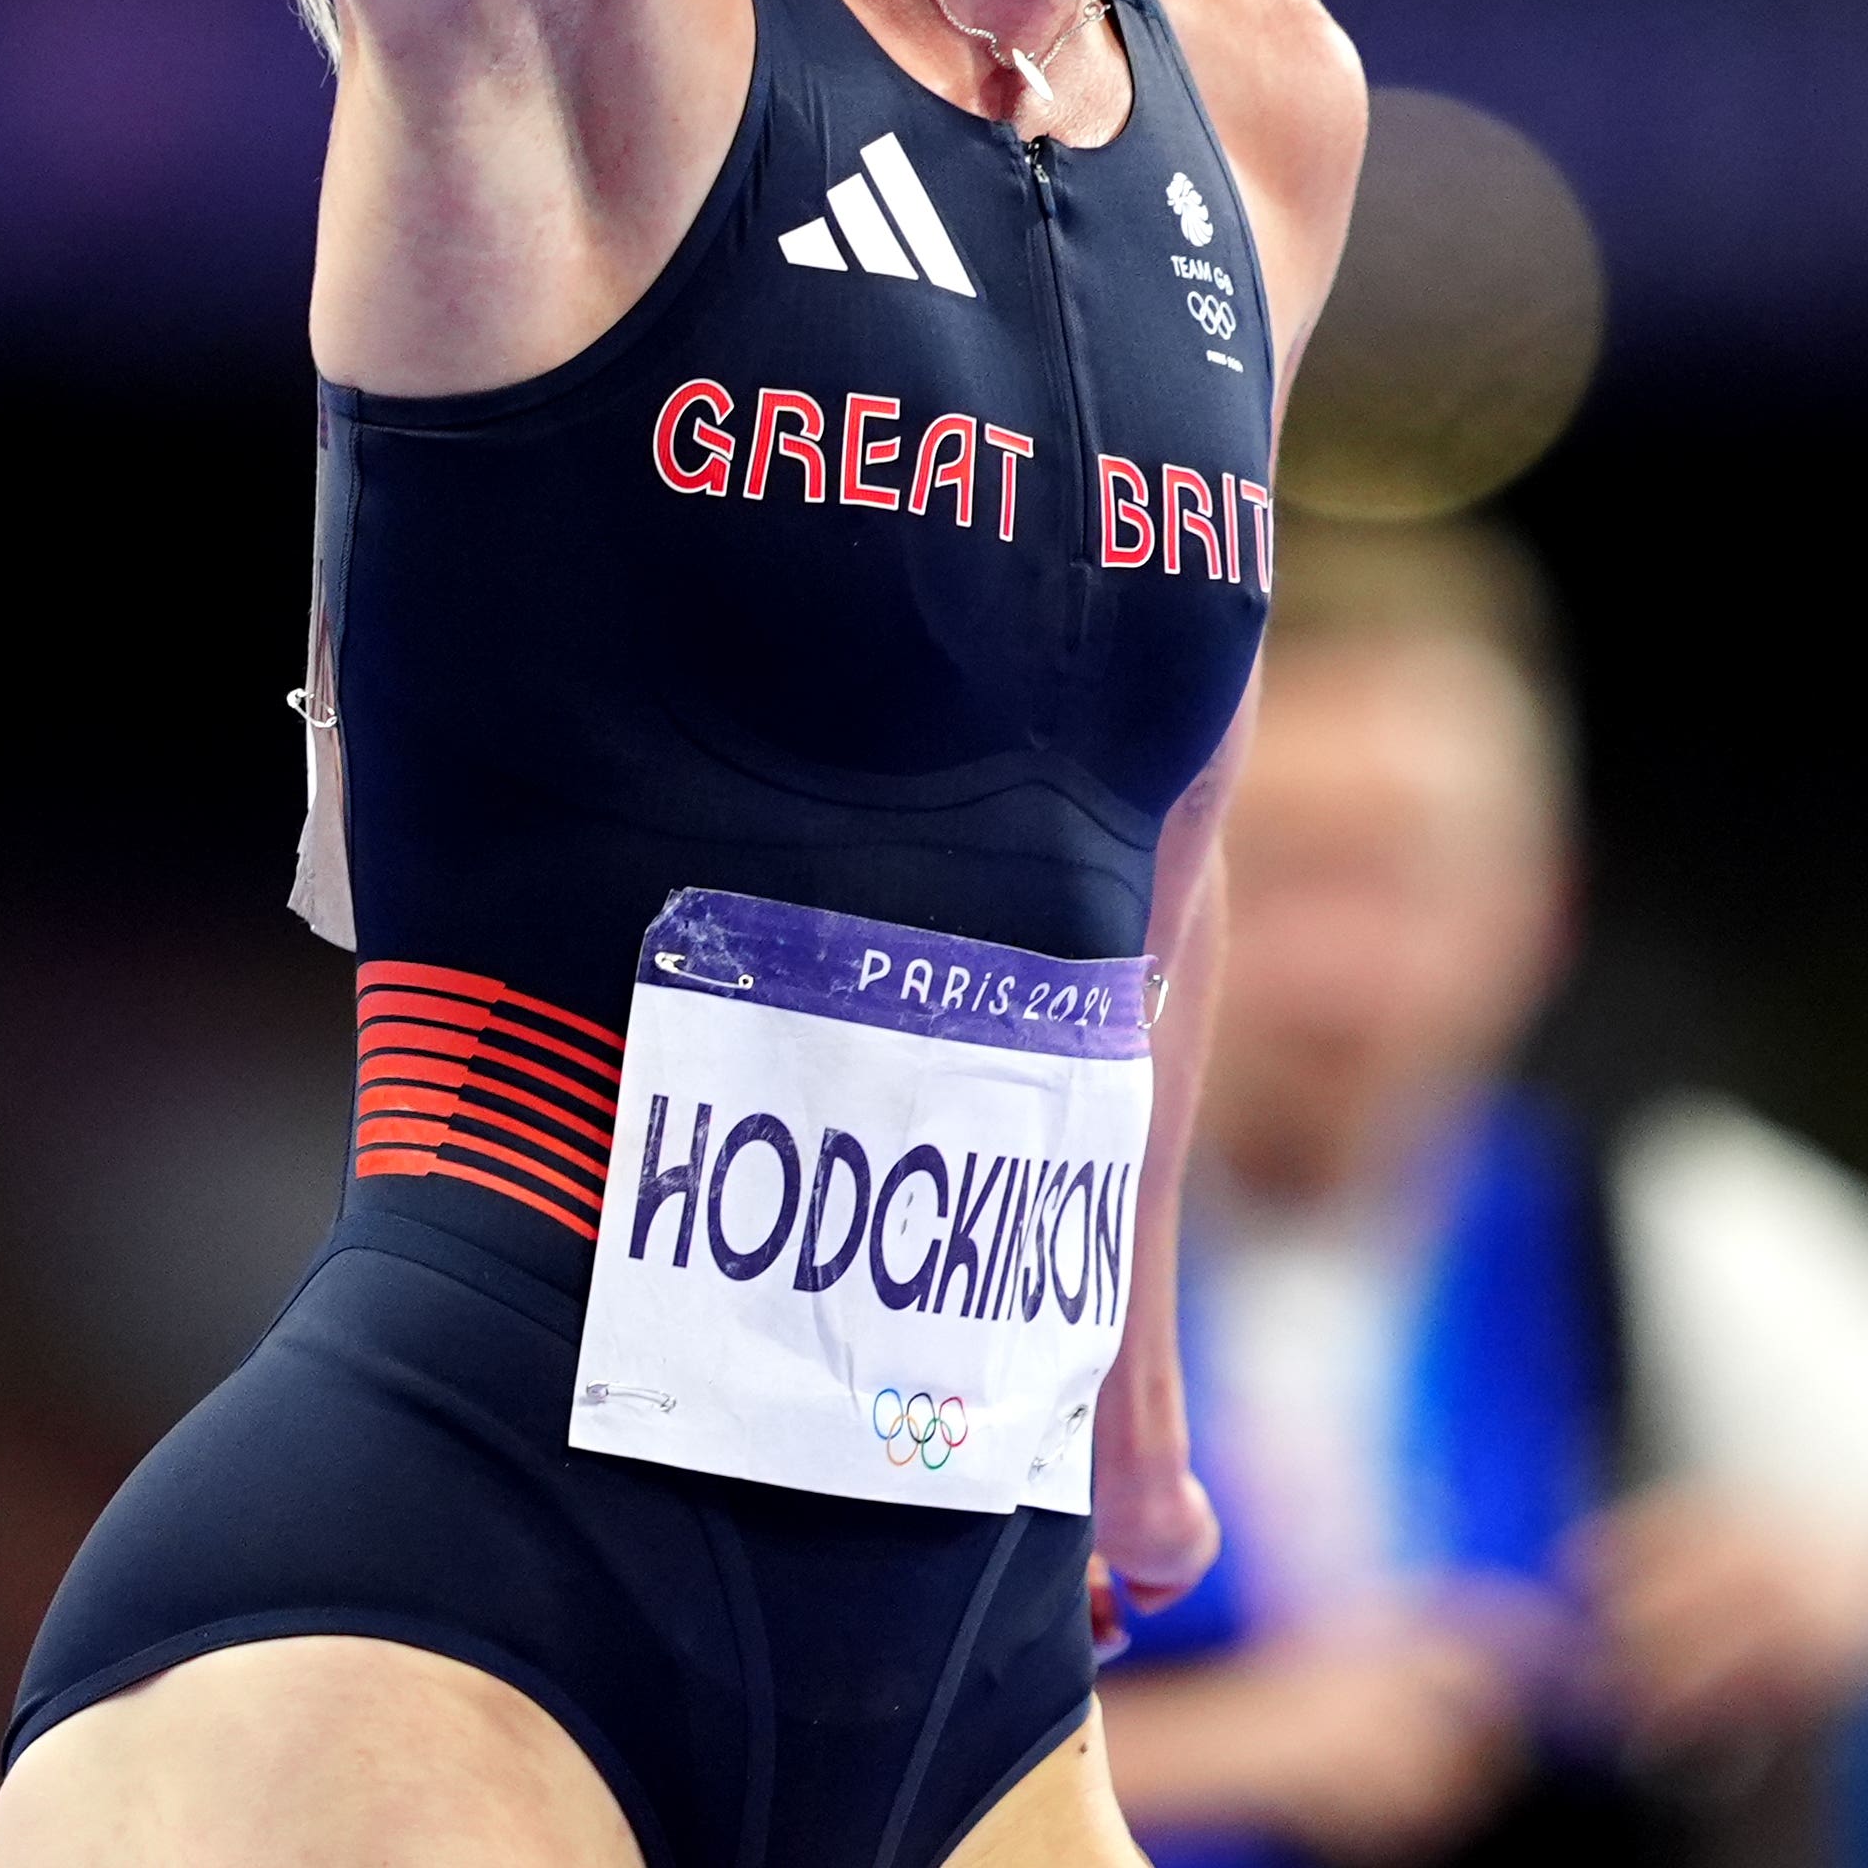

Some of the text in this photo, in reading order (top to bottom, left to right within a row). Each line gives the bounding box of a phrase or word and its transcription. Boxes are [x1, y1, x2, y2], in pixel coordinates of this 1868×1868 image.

[1170, 255, 1213, 282] TEAM
[652, 377, 1274, 593] GREAT BRIT
[1022, 982, 1112, 1027] 2024
[628, 1093, 1131, 1327] HODGKINSON
